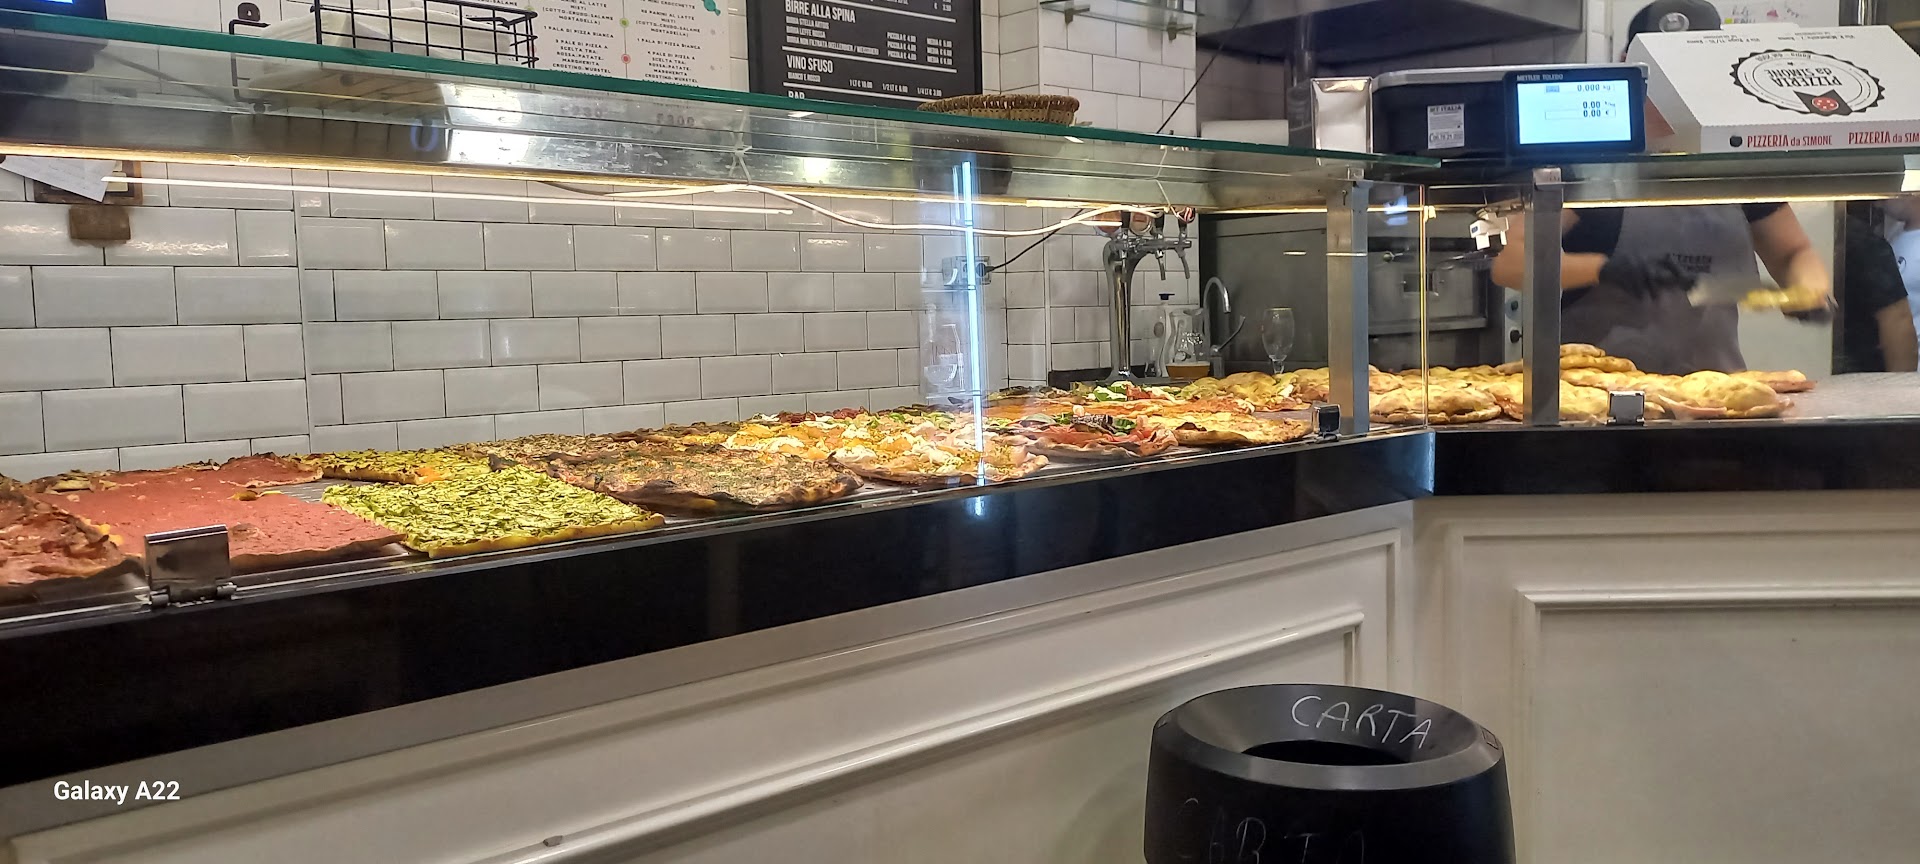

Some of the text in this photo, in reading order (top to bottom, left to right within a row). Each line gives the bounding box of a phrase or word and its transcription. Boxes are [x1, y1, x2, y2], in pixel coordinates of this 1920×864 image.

[785, 0, 856, 23] BIRRE ALLA SPINA
[786, 54, 833, 73] VINO SFUSO
[1517, 73, 1564, 82] METTLER TOLEDO
[1764, 67, 1832, 78] da SIMONE
[1577, 83, 1600, 92] 0.000
[1770, 75, 1843, 88] PIZZERIA
[1582, 101, 1601, 110] 0.00
[1583, 109, 1602, 118] 0.00
[1747, 134, 1833, 148] PIZZERIA da SIMONE
[1848, 131, 1891, 145] PIZZERIA
[1893, 134, 1903, 143] da
[1291, 696, 1432, 748] CARTA
